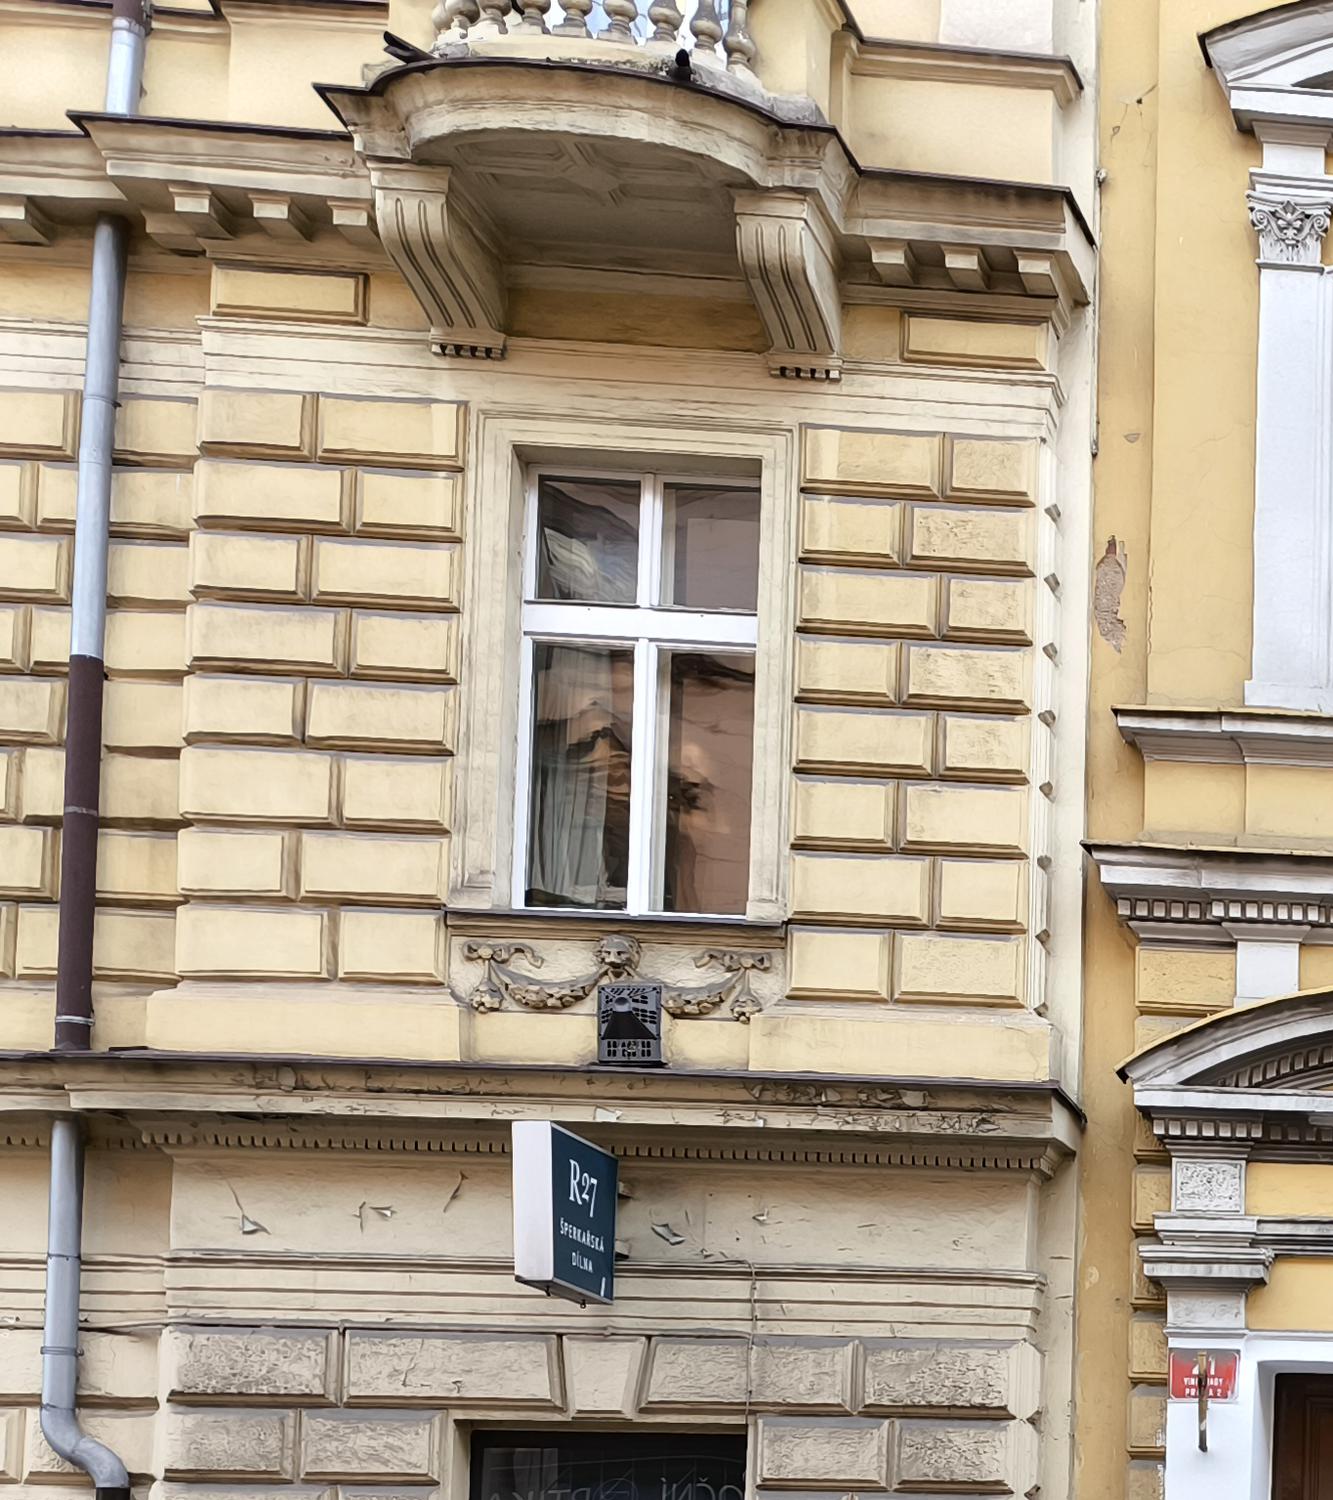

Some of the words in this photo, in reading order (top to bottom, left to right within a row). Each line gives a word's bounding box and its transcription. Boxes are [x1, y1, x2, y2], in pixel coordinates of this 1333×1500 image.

[568, 1158, 598, 1218] R27
[560, 1217, 605, 1252] ŠPERKAŘSKÁ
[571, 1251, 594, 1274] DÍLNA
[1183, 1377, 1224, 1386] VINADY
[1185, 1388, 1214, 1397] PRA
[1216, 1388, 1223, 1397] 2
